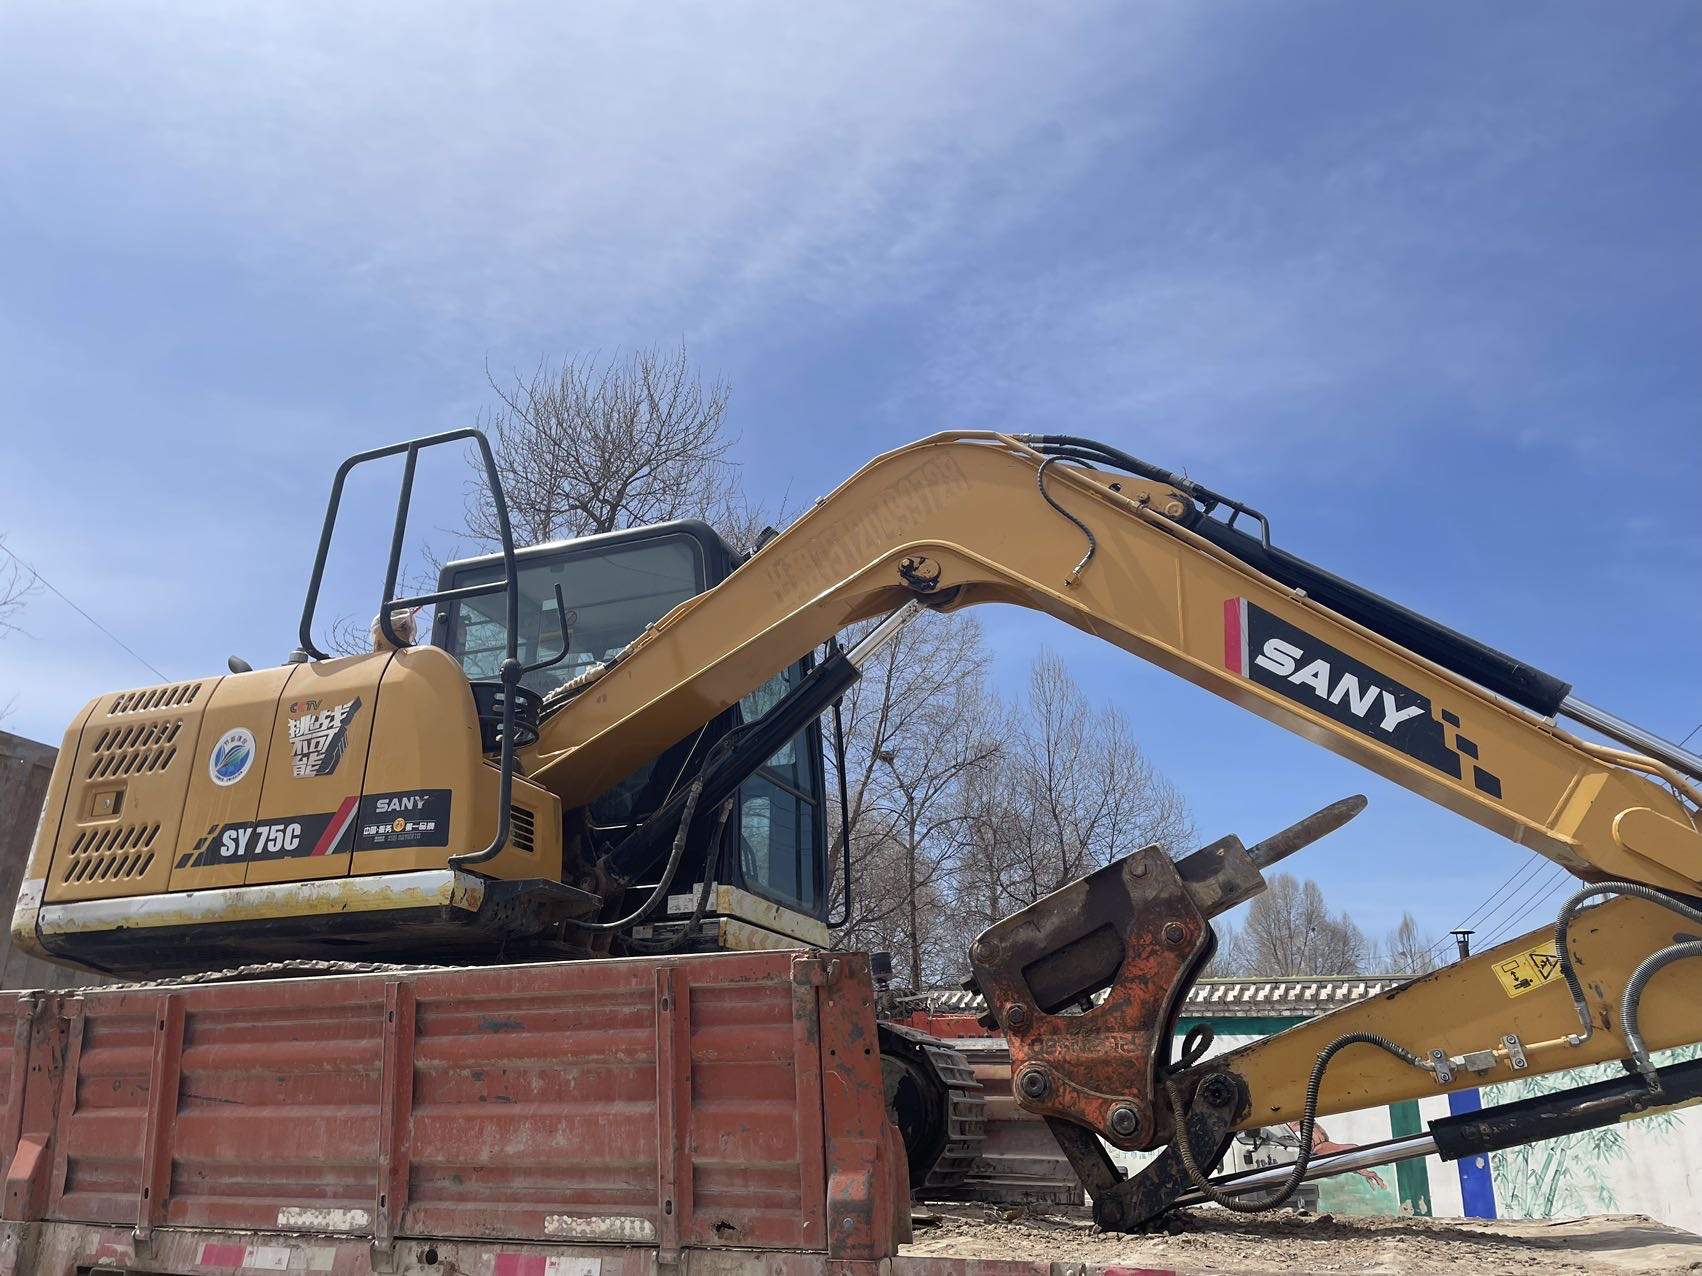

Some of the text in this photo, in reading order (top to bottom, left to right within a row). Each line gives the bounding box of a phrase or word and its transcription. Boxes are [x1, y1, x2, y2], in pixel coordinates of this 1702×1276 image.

[1254, 638, 1426, 733] SANY
[288, 699, 355, 738] 挑战
[289, 699, 322, 713] CCTV
[289, 727, 340, 756] 不可
[291, 752, 326, 779] 能
[376, 796, 430, 813] SANY
[220, 823, 302, 857] SY 75C
